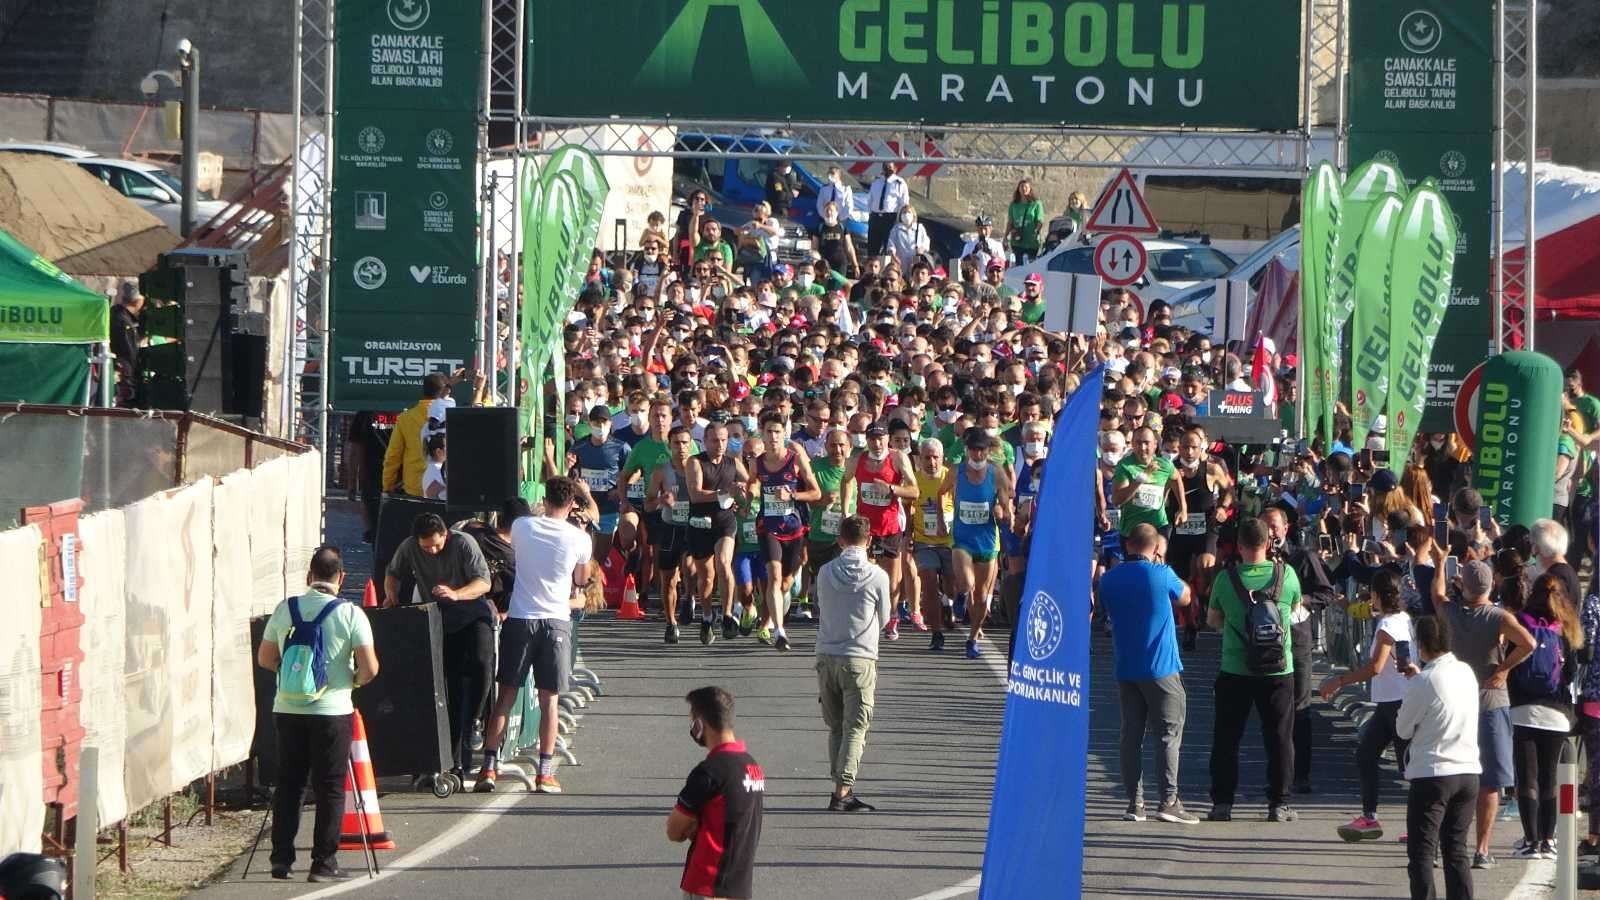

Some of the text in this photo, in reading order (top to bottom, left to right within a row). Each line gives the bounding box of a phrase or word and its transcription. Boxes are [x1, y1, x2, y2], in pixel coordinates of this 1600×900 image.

[837, 71, 1204, 108] MARATONU
[341, 356, 464, 377] TURSET
[349, 378, 390, 386] PROJECT
[1225, 394, 1254, 406] PLUS
[1499, 398, 1522, 526] MARATONU
[1068, 672, 1081, 689] VE
